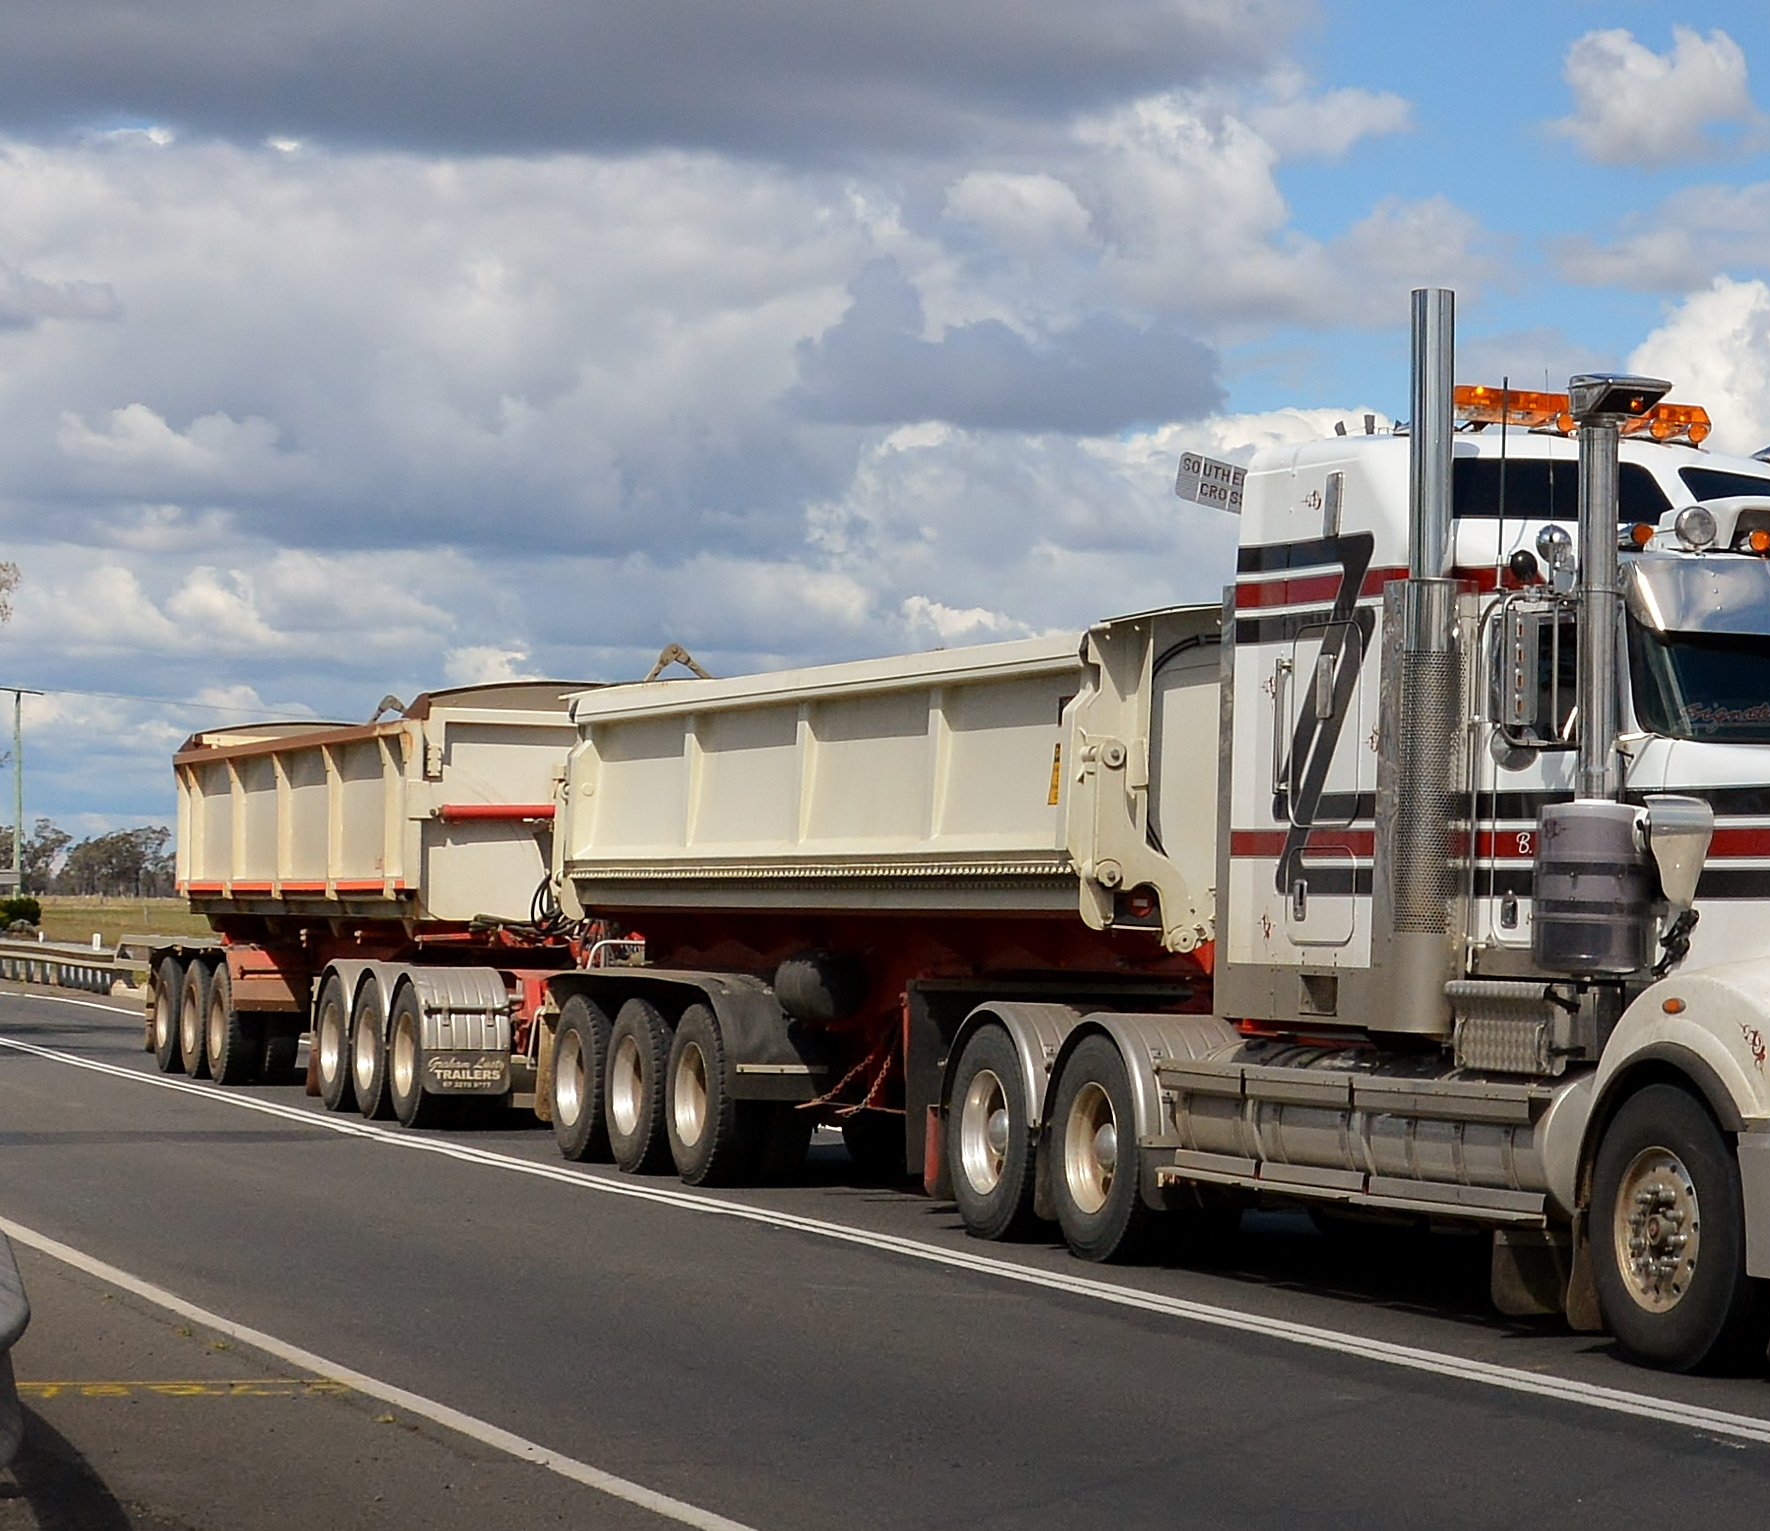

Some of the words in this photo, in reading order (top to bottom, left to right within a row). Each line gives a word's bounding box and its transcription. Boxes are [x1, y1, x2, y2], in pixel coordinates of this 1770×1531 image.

[1183, 458, 1244, 487] SOUTHE
[1516, 832, 1532, 853] B.
[434, 1070, 501, 1080] TRAILERS
